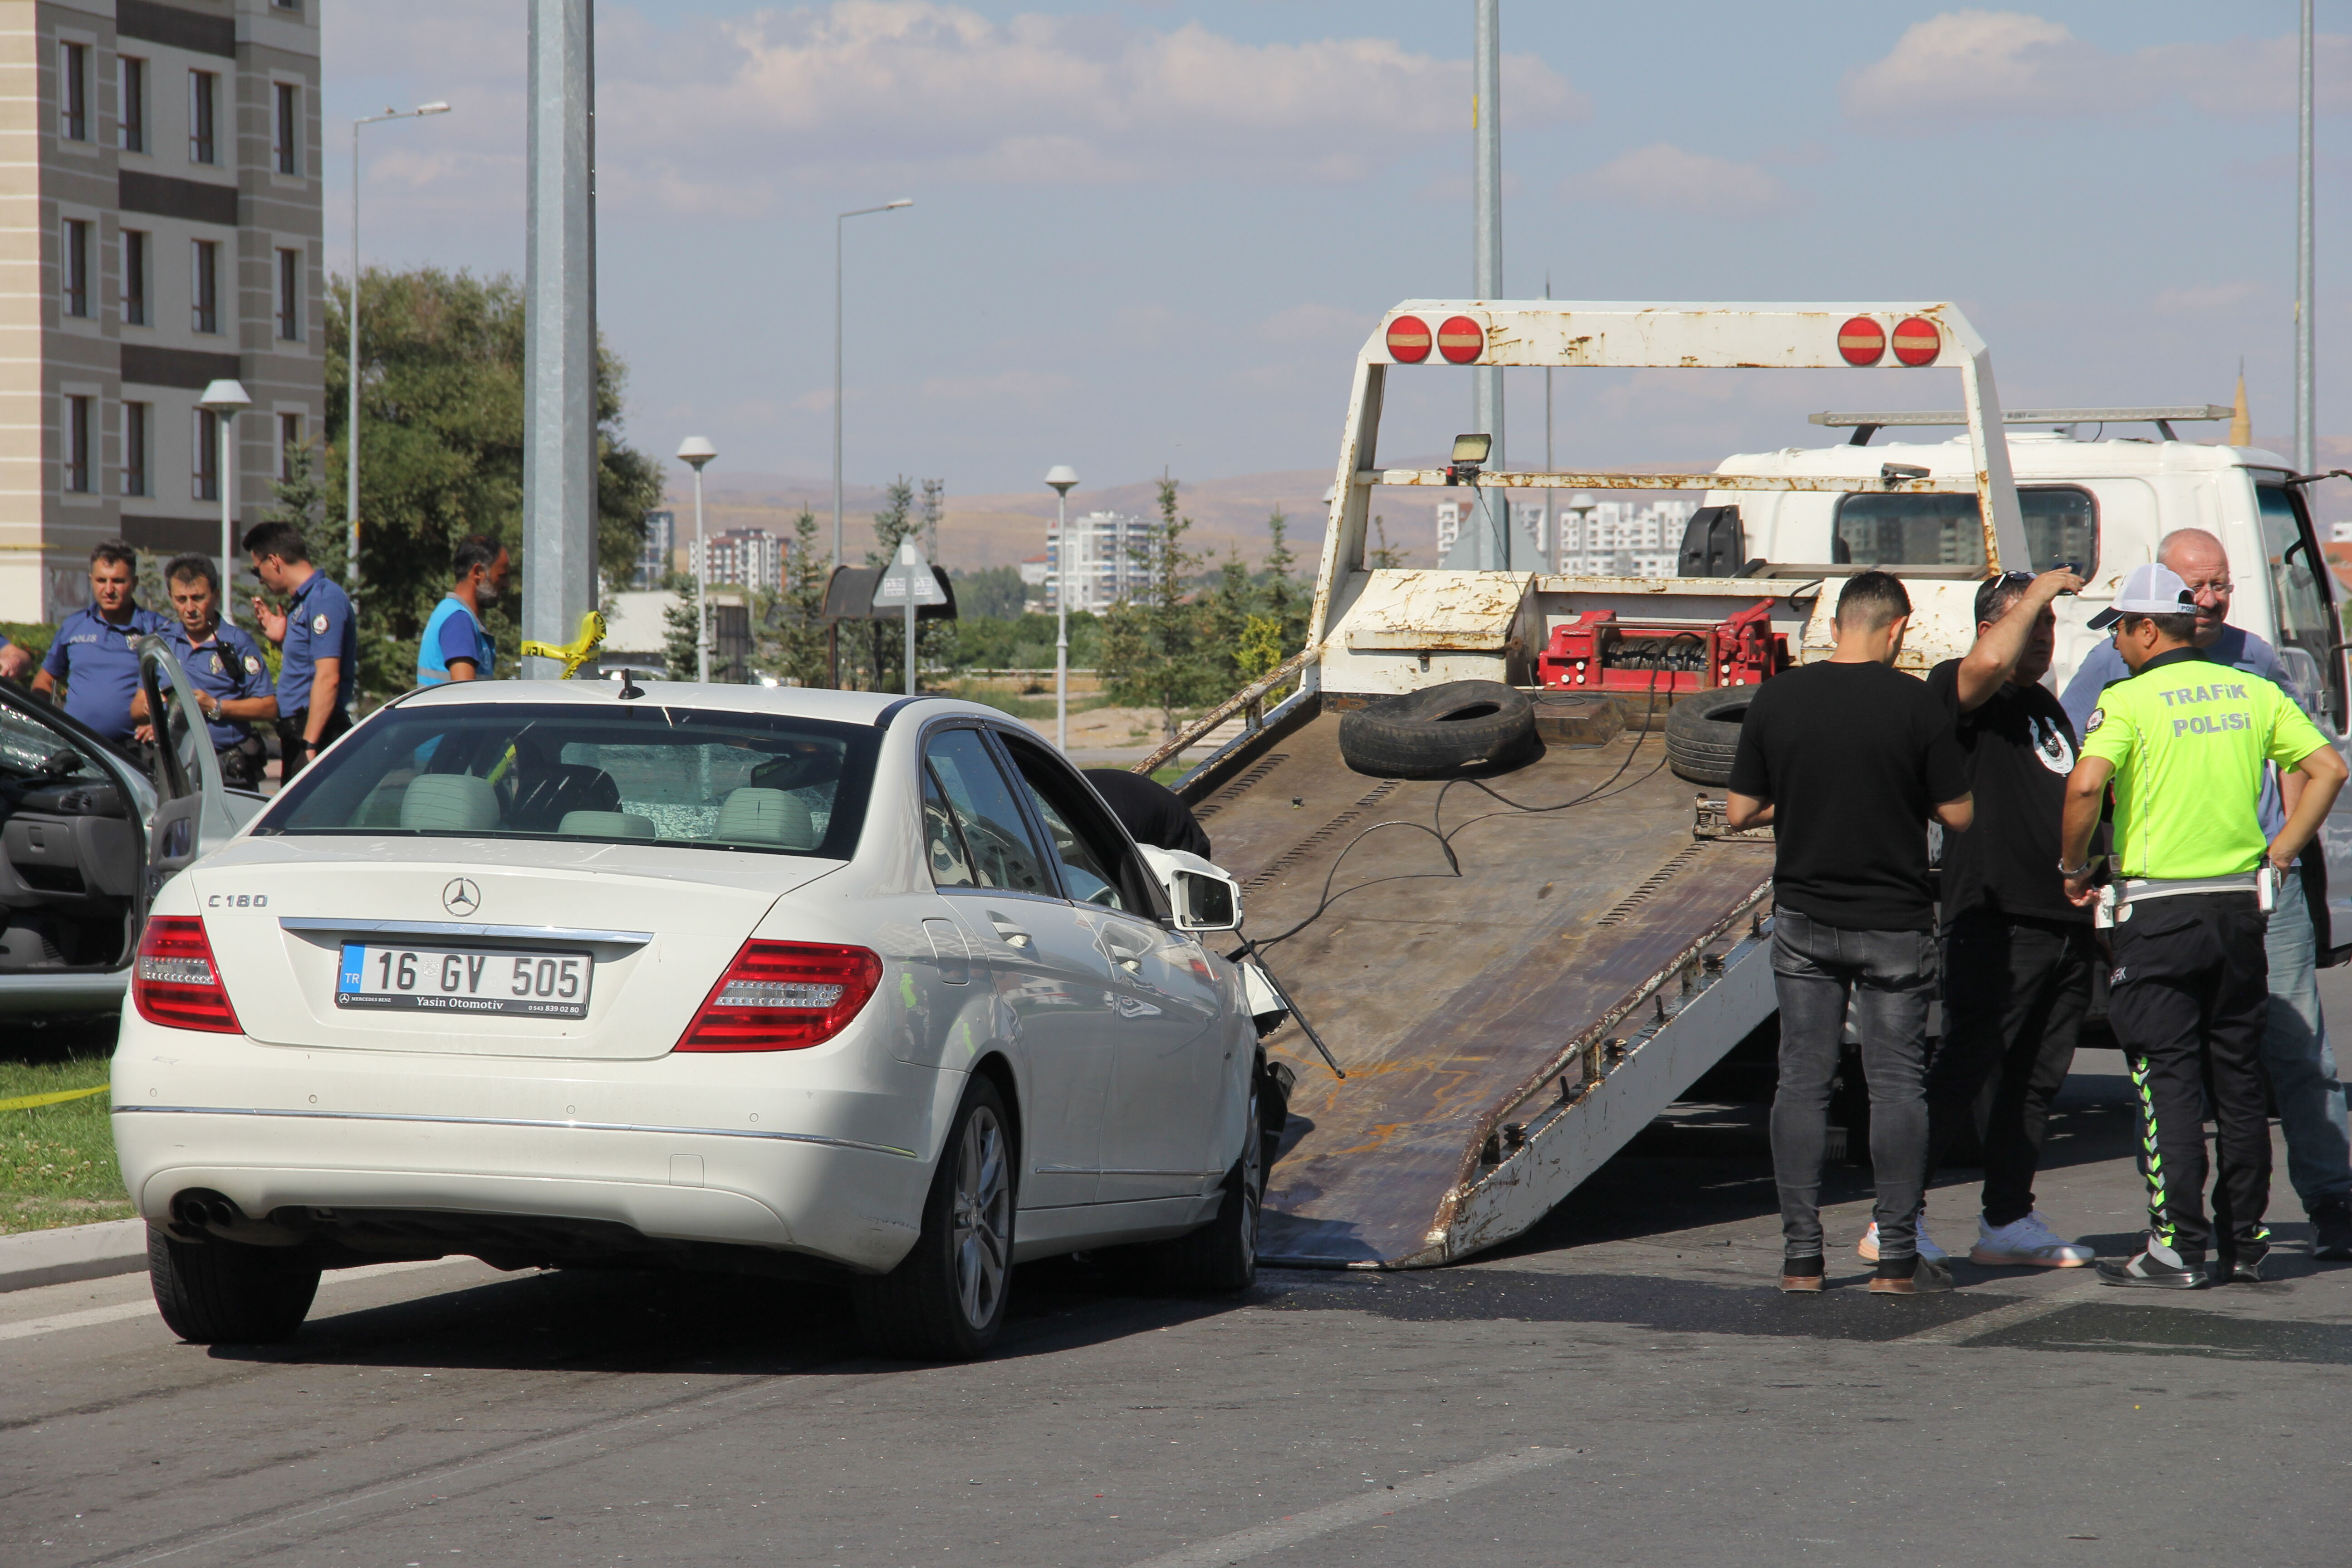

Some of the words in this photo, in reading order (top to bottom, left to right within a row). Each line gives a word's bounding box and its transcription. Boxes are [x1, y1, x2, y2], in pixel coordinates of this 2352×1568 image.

[208, 895, 221, 907] C
[226, 894, 268, 907] 180
[345, 973, 360, 984] TR
[379, 952, 417, 990] 16
[441, 955, 486, 993] GV
[512, 958, 579, 998] 505
[416, 997, 446, 1007] Yasin
[449, 998, 504, 1009] Otomotiv
